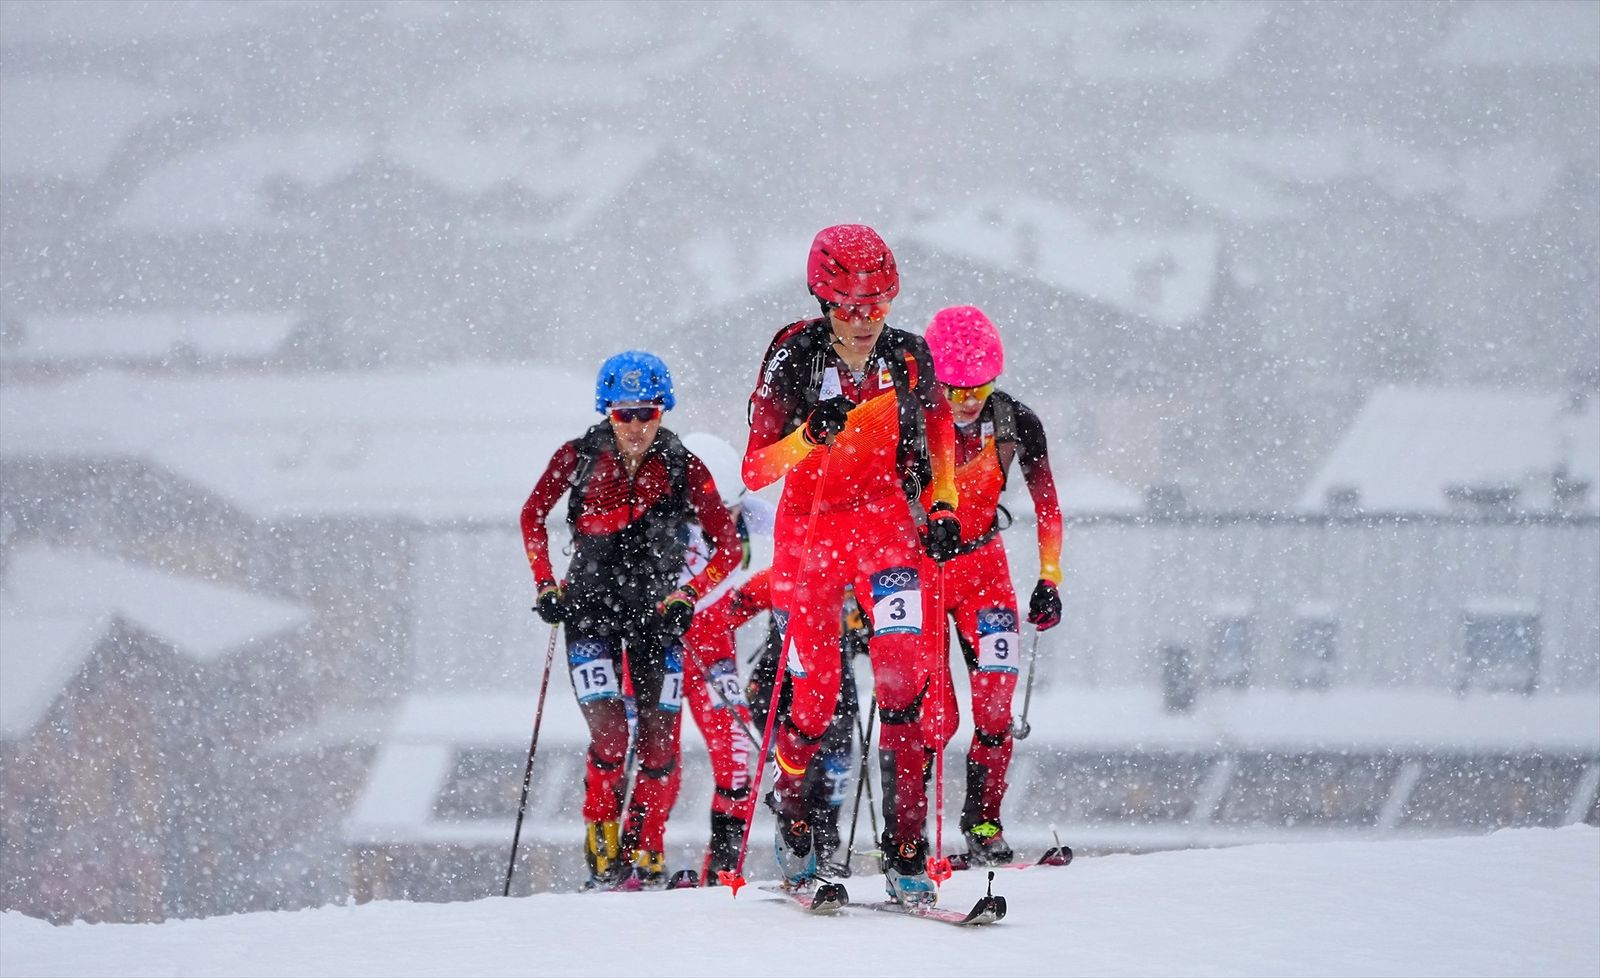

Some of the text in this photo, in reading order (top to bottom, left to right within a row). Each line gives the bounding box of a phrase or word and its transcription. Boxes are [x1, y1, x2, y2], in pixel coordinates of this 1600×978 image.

[889, 597, 907, 620] 3
[994, 638, 1009, 660] 9
[579, 666, 608, 690] 15
